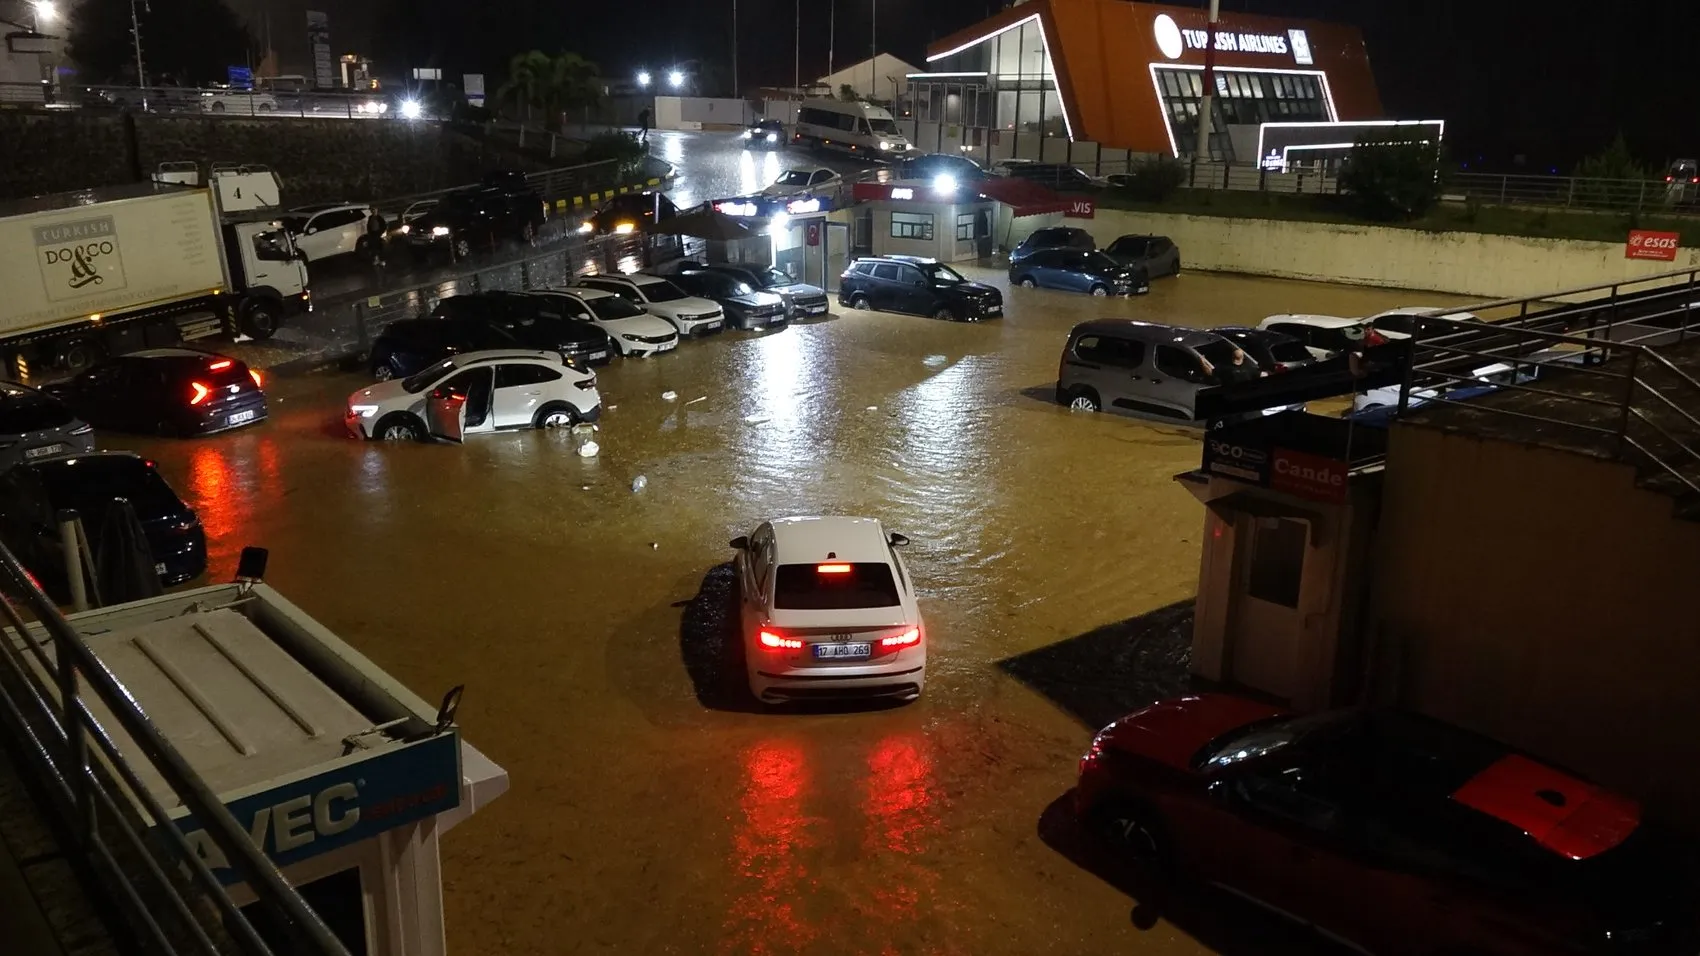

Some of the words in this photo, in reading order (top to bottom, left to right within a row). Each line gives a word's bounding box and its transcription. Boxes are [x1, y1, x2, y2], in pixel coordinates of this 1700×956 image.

[1239, 33, 1288, 54] AIRLINES
[233, 187, 242, 200] 4
[1070, 201, 1092, 214] VIS
[41, 221, 110, 241] TURKISH
[1644, 236, 1677, 249] esas
[1274, 457, 1343, 486] Cande
[819, 646, 828, 656] 17
[853, 645, 869, 655] 269
